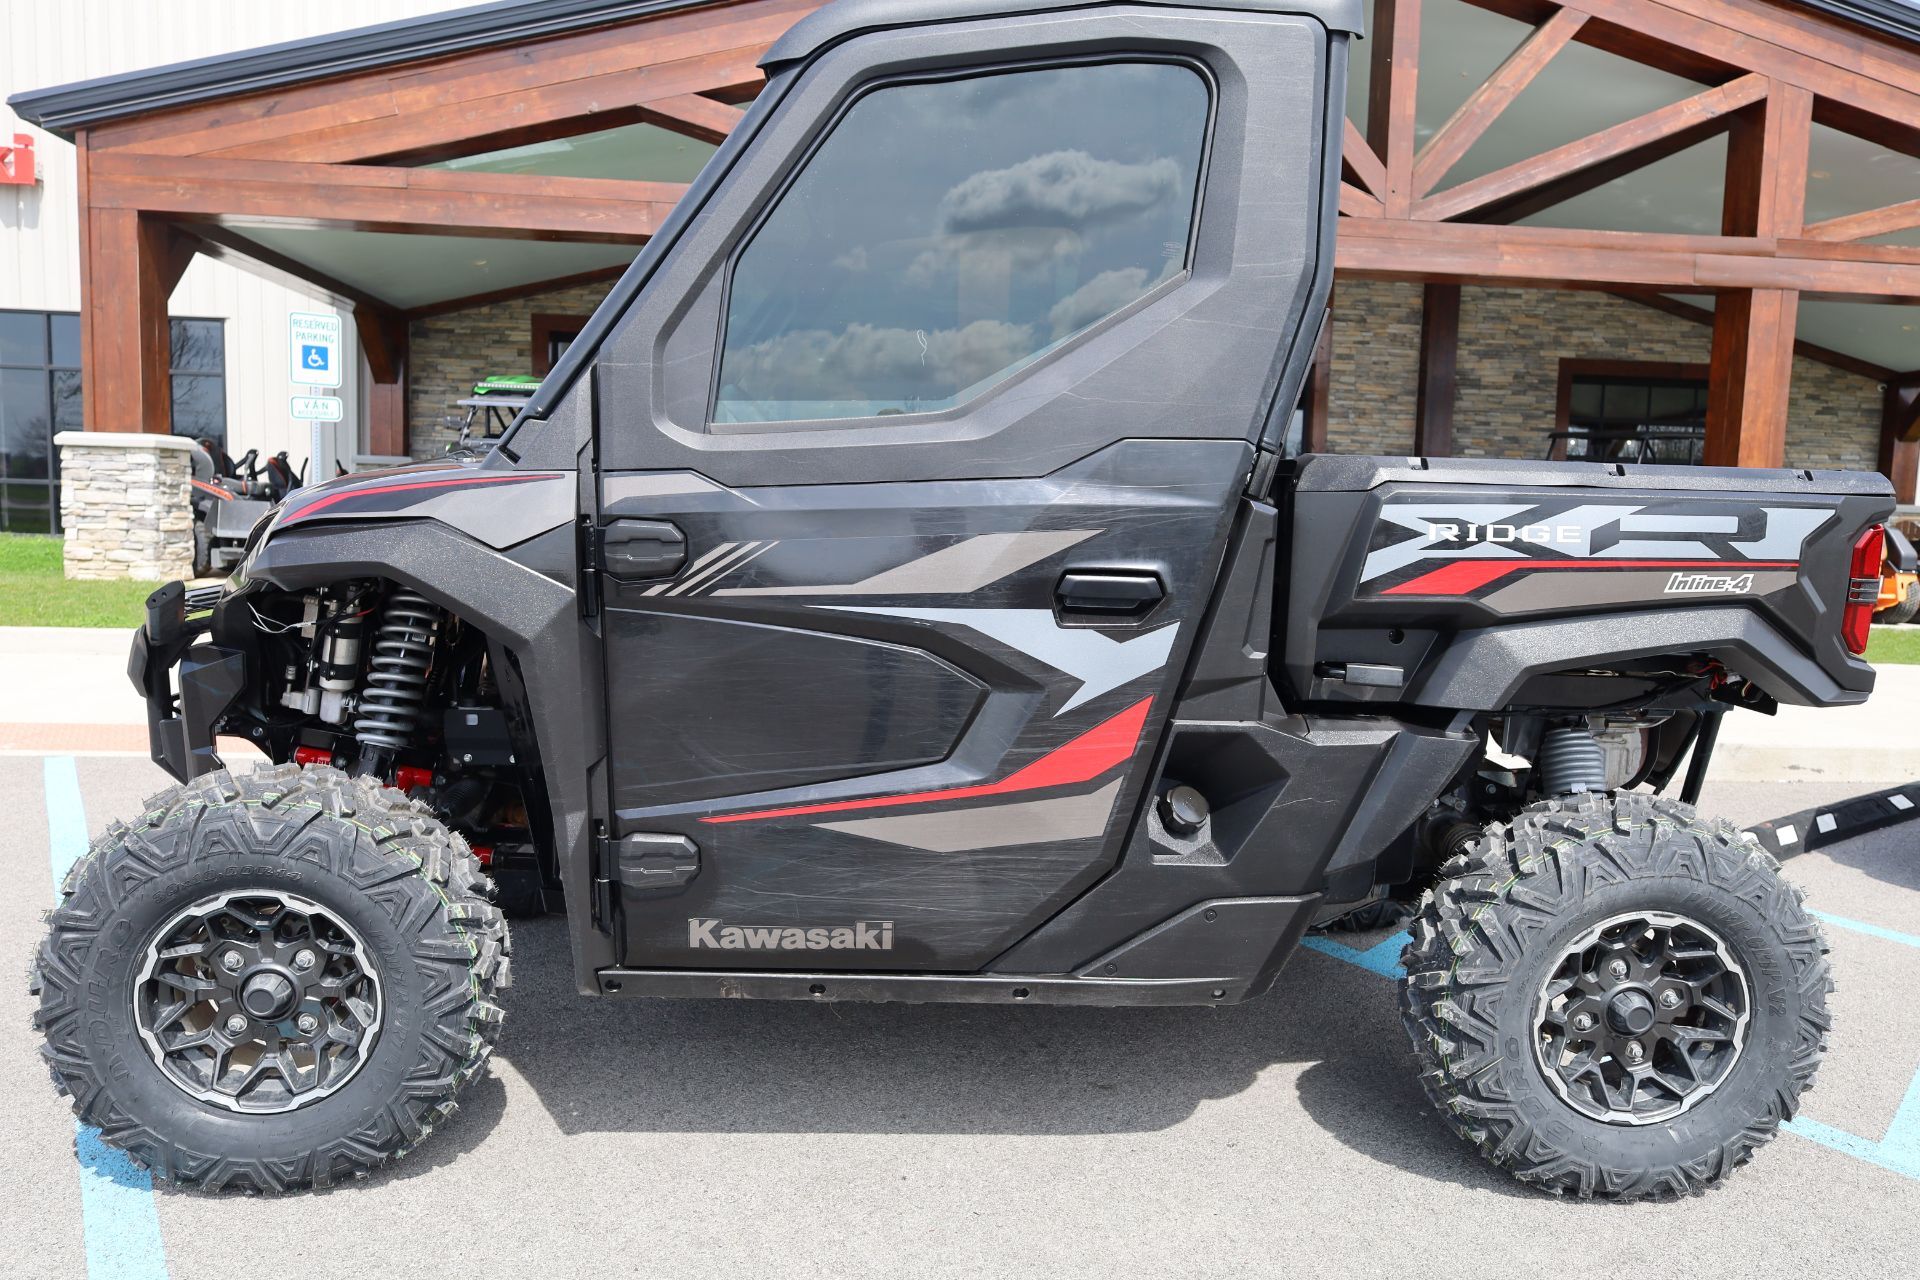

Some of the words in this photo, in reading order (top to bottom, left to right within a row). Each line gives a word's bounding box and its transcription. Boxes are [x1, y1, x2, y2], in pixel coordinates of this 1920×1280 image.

[292, 318, 338, 332] RESERVED
[295, 331, 335, 344] PARKING
[303, 400, 329, 410] VAN
[1427, 523, 1583, 544] RIDGE
[1664, 572, 1755, 594] Inline-4
[688, 919, 894, 951] Kawasaki
